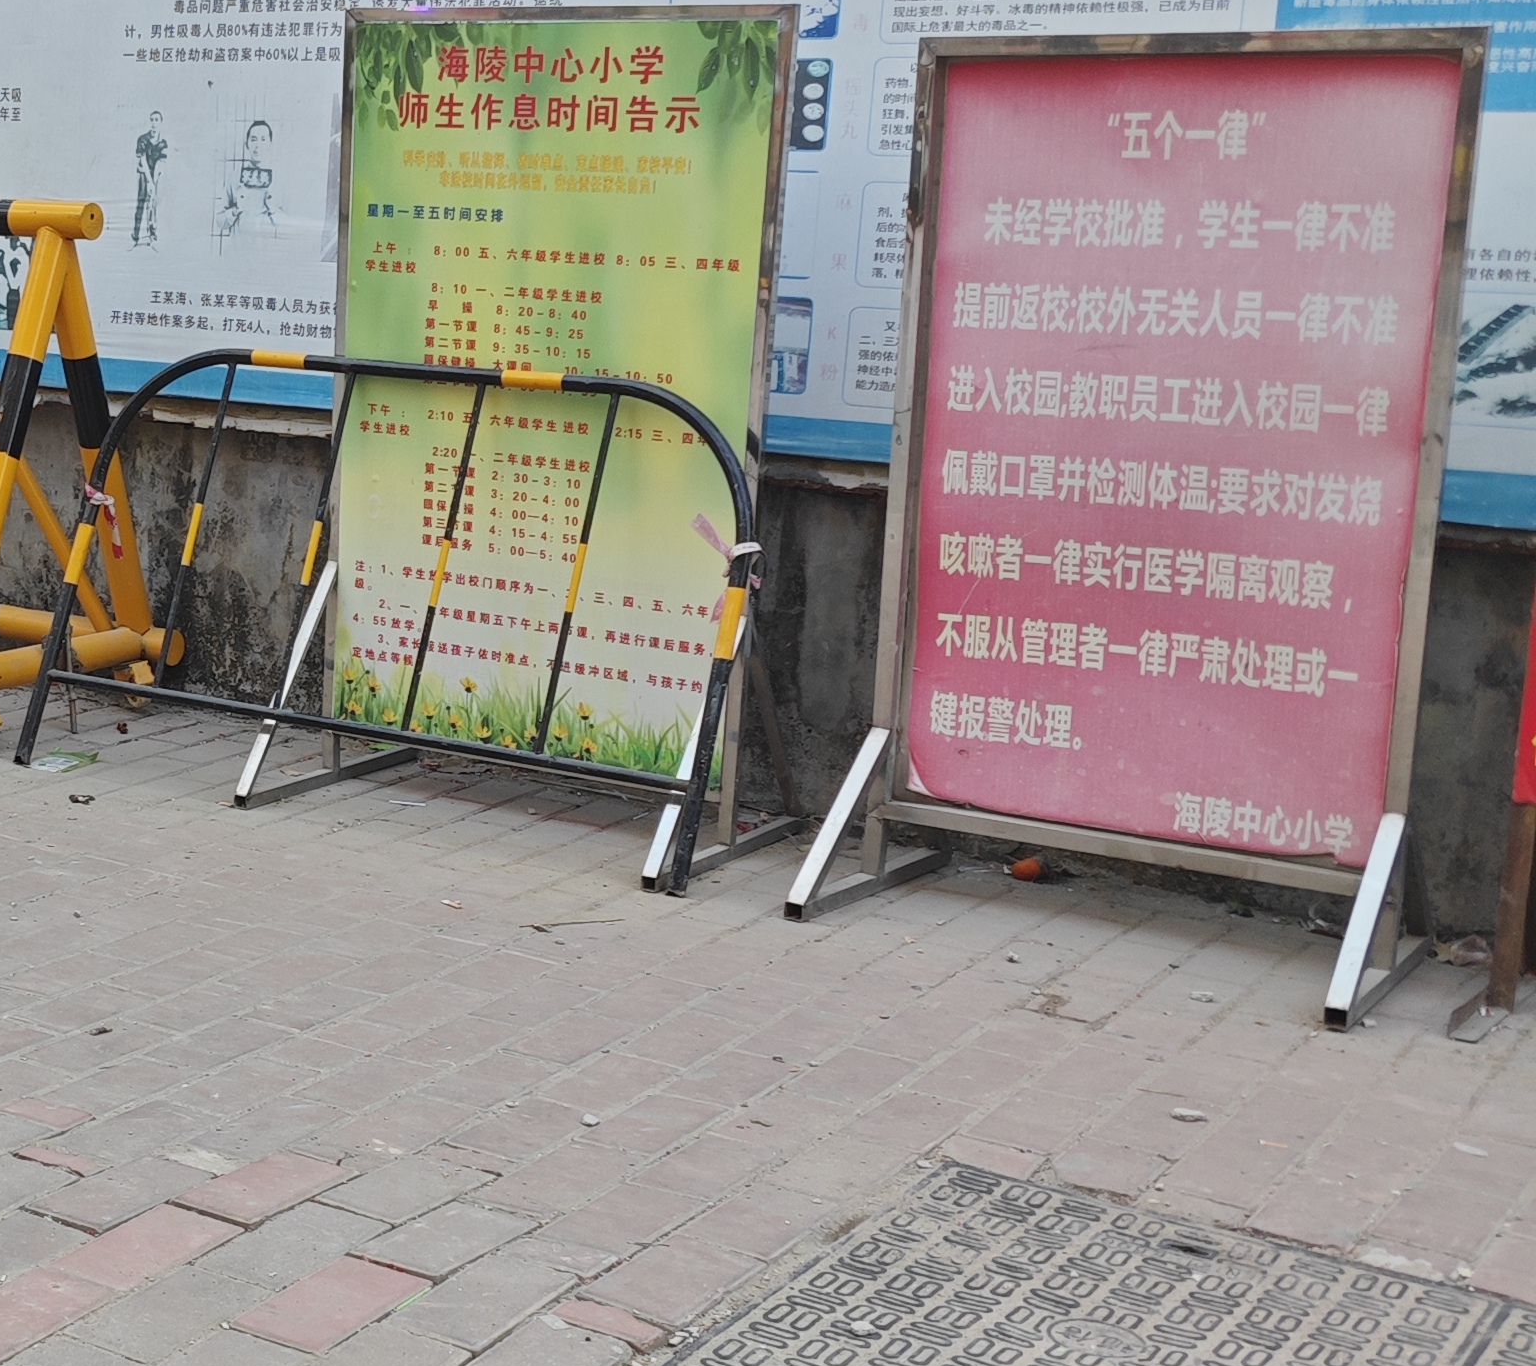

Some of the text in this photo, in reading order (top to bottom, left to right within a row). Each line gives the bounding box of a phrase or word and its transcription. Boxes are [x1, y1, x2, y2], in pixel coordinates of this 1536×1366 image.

[124, 21, 343, 40] 计，男性吸毒人员80%有违法犯罪行为
[891, 19, 1048, 34] 国际上危害最大的毒品之一。
[122, 47, 341, 63] 一些地区抢劫和盗窃案中60%以上是吸
[436, 44, 666, 85] 海陵中心小学
[397, 92, 702, 134] 师生作息时间告示
[1106, 109, 1268, 161] “五个一律”
[366, 203, 505, 223] 星期一至五时间安排
[984, 196, 1396, 254] 未经学校批准，学生一律不准
[365, 259, 418, 275] 学生进校
[477, 246, 606, 266] 五、六年级学生进校
[663, 256, 742, 273] 三、四年级
[1468, 247, 1536, 263] 各自的
[474, 286, 603, 305] 一、二年级学生进校
[109, 310, 337, 339] 开封等地作案多起，打死4人，抢劫财物
[424, 316, 478, 334] 第一节课
[952, 281, 1400, 347] 提前返校;校外无关人员一律不准
[424, 335, 477, 352] 第二节课
[857, 349, 898, 362] 强的依
[856, 363, 897, 377] 神经中
[946, 365, 1391, 437] 进入校园;教职员工进入校园一律
[359, 420, 411, 437] 学生进校
[942, 448, 1383, 526] 佩戴口罩并检测体温;要求对发烧
[423, 498, 475, 517] 眼保操
[939, 533, 1354, 614] 咳嗽者一律实行医学隔离观察，
[378, 598, 714, 658] 2、一、年级星期五下午上两课，再进行课后服务，
[935, 611, 1360, 697] 不服从管理者一律严肃处理或一
[929, 689, 1083, 751] 键报警处理。
[1172, 790, 1354, 855] 海陵中心小学
